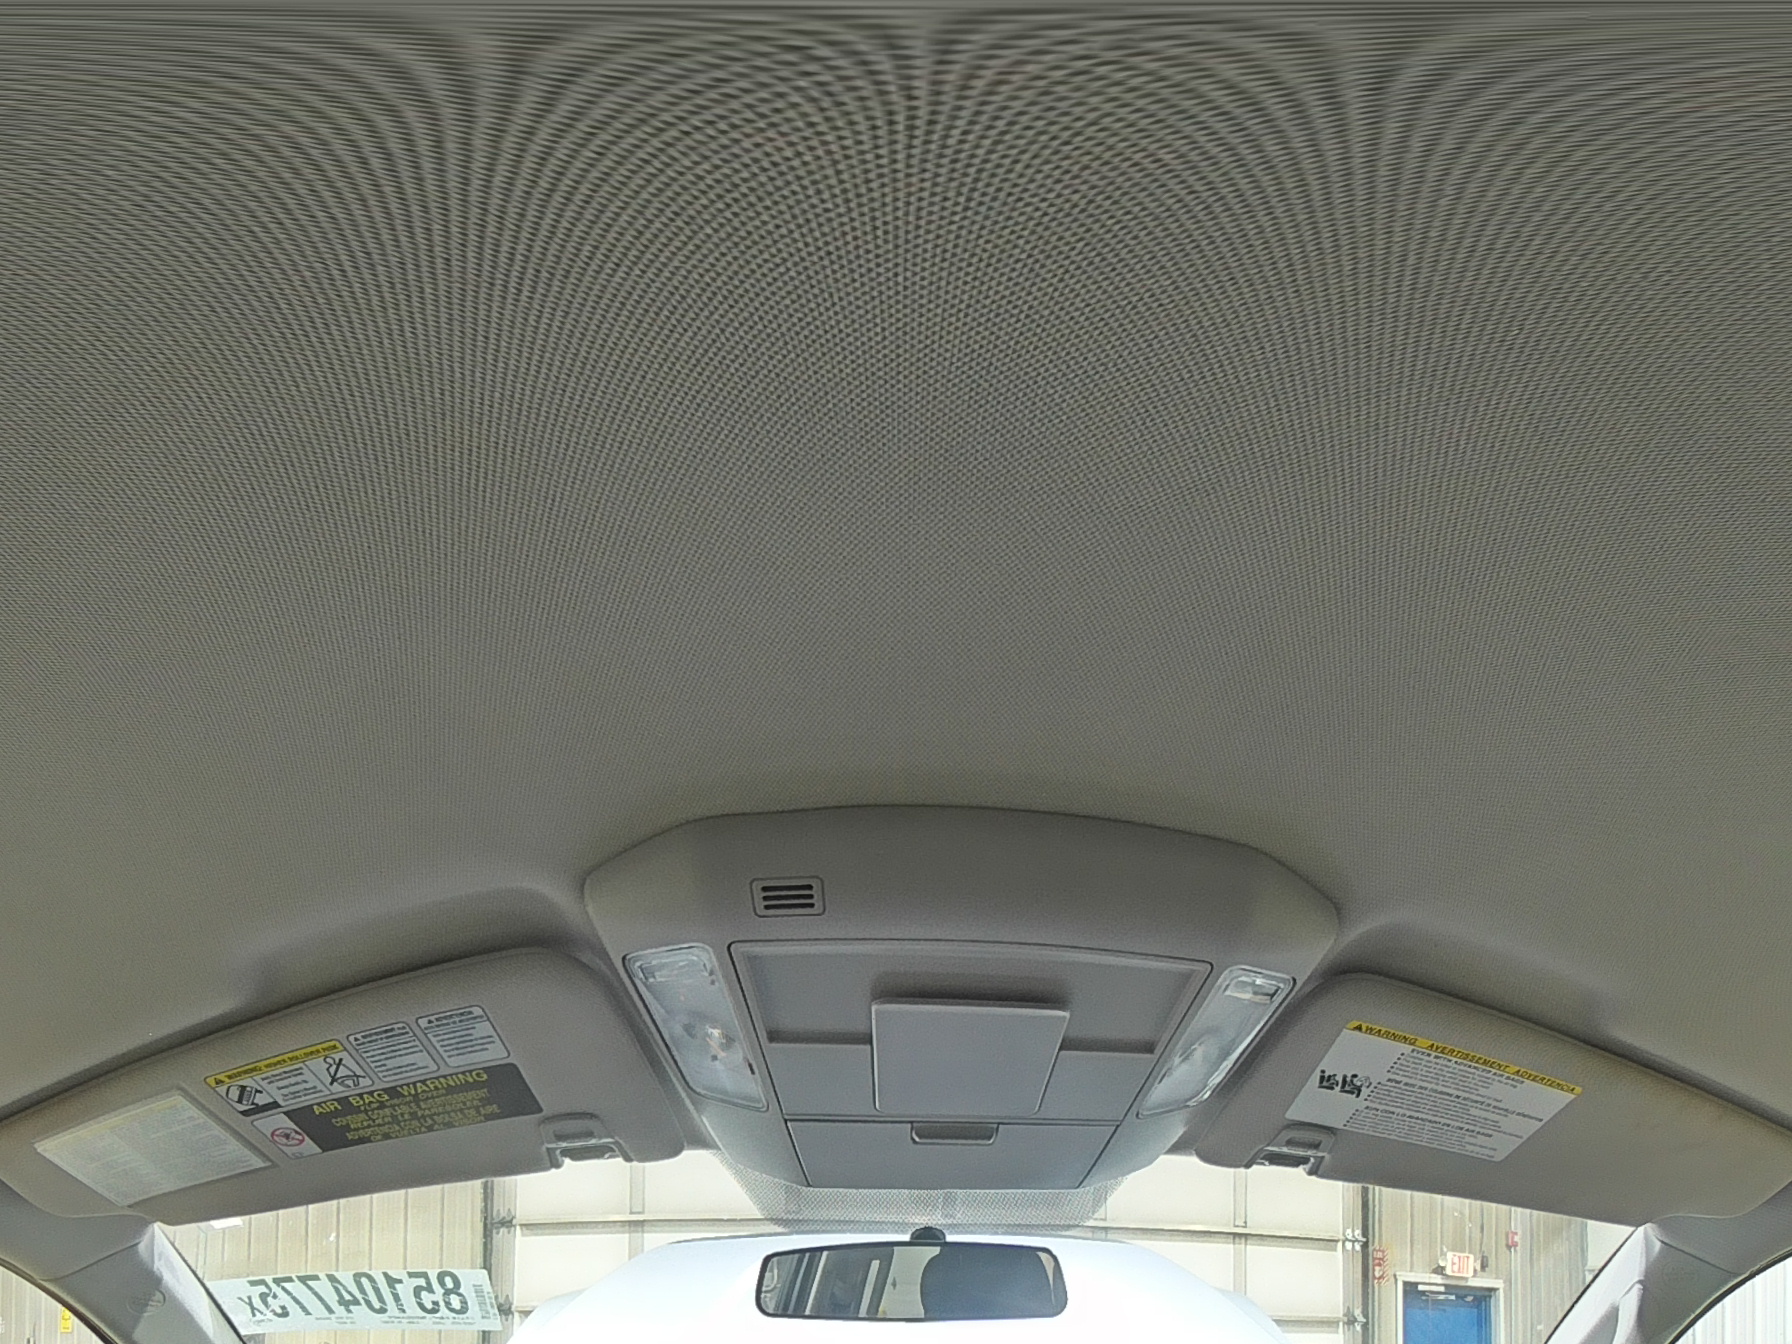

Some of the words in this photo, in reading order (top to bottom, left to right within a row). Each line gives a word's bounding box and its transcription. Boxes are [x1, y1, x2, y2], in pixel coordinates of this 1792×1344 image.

[1362, 1025, 1418, 1046] WARNING
[1424, 1042, 1509, 1072] AVERTISSEMENT
[1511, 1067, 1578, 1093] ADVERTENCIA
[312, 1101, 341, 1115] AIR
[350, 1090, 389, 1107] BAG
[397, 1069, 488, 1098] WARNING
[1451, 1253, 1470, 1274] EXIT
